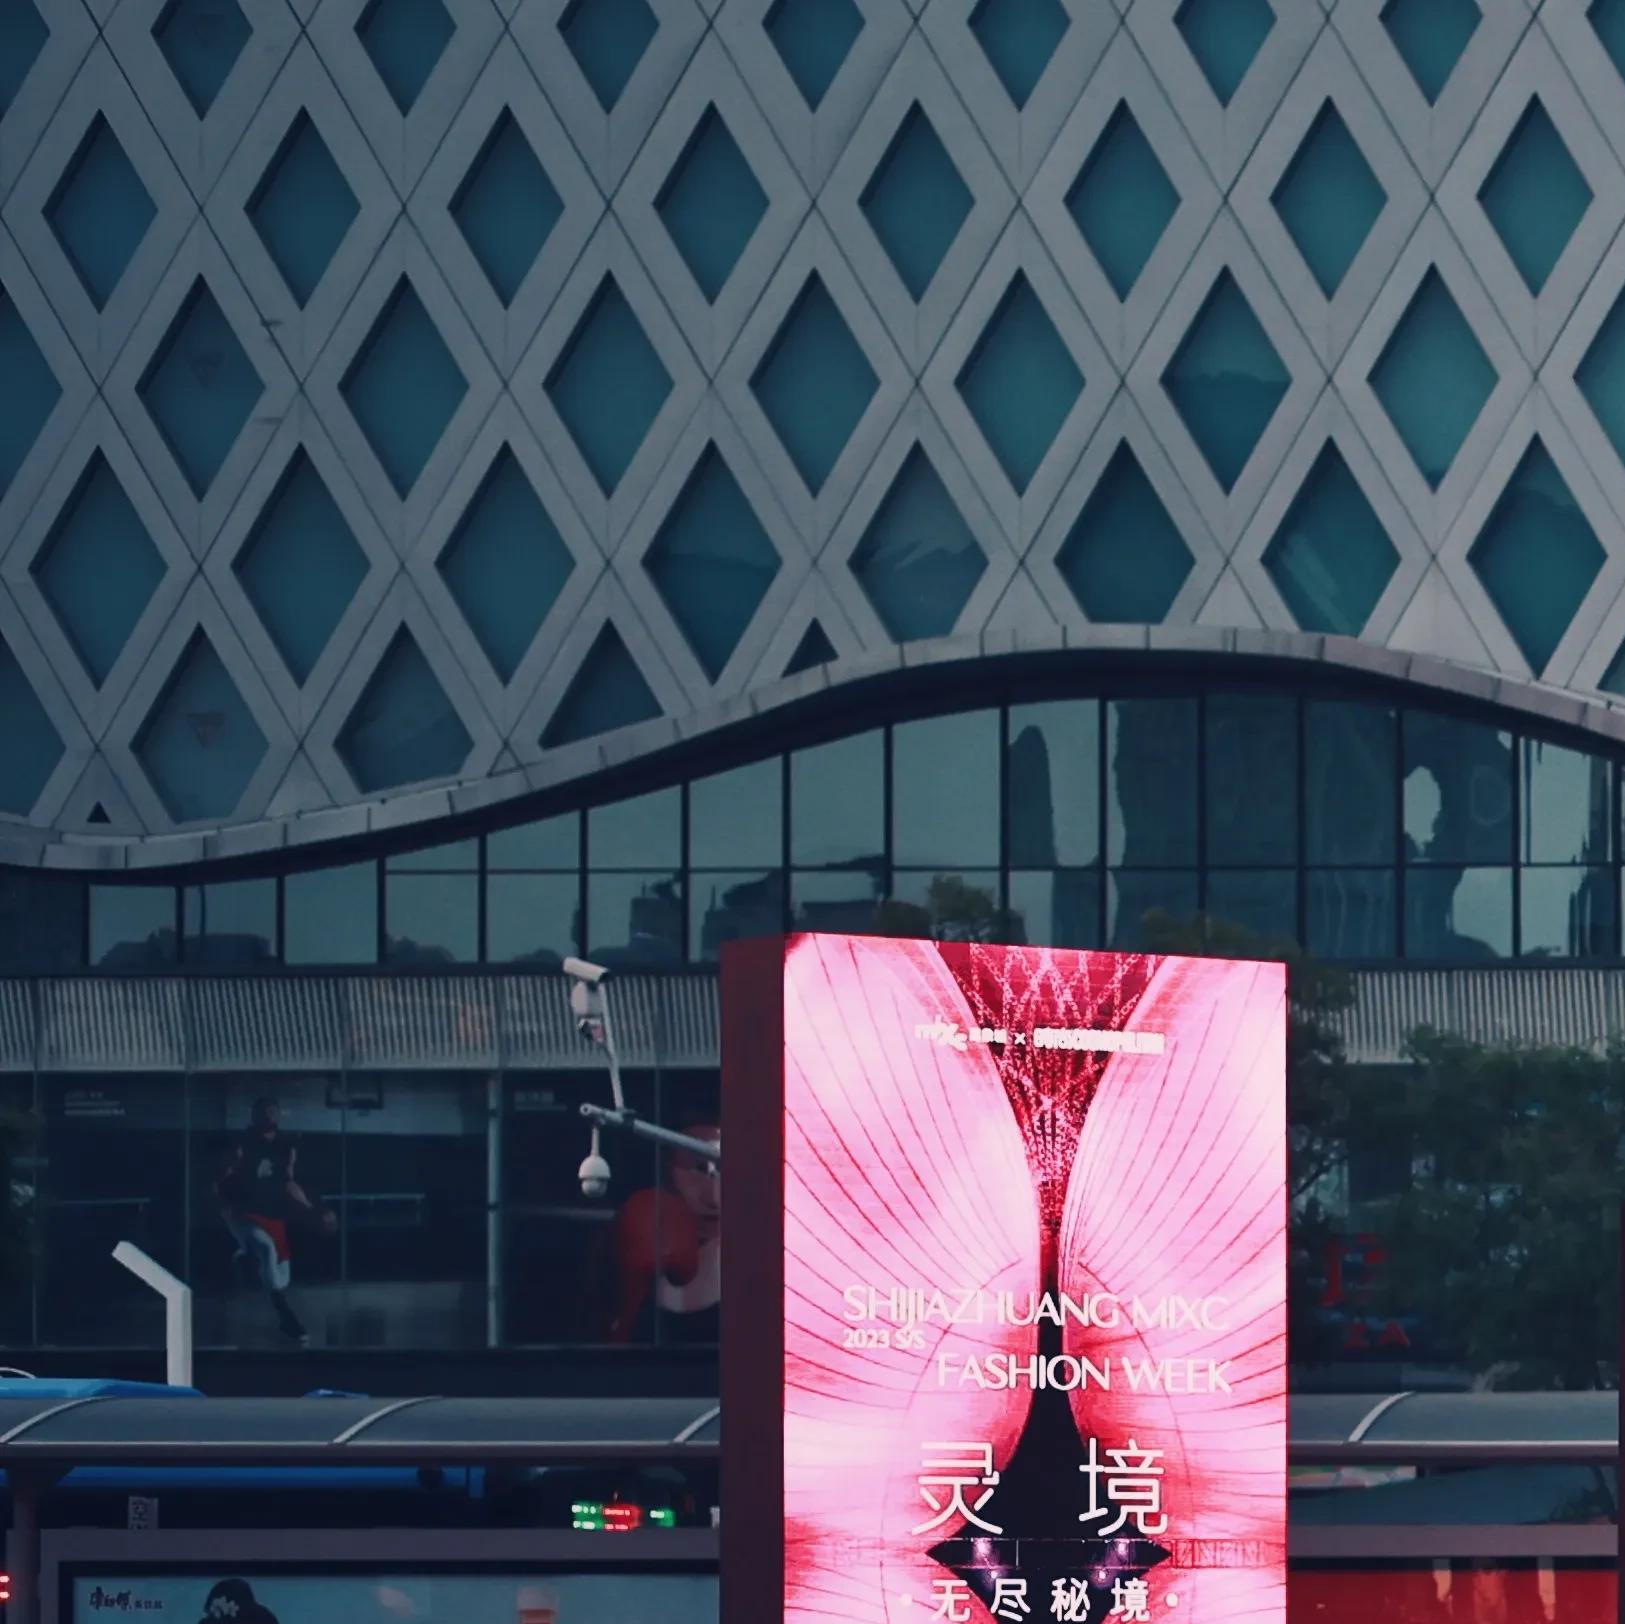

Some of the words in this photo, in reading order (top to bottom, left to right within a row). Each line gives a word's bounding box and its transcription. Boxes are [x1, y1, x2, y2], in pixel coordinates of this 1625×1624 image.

[843, 1284, 1120, 1333] SHIJIAZHUANG
[1132, 1297, 1231, 1332] MIXC
[843, 1329, 890, 1350] 2023
[937, 1353, 1110, 1393] FASHION
[1122, 1356, 1233, 1395] WEEK
[912, 1437, 1168, 1536] 灵境
[929, 1576, 1151, 1624] 无尽秘境
